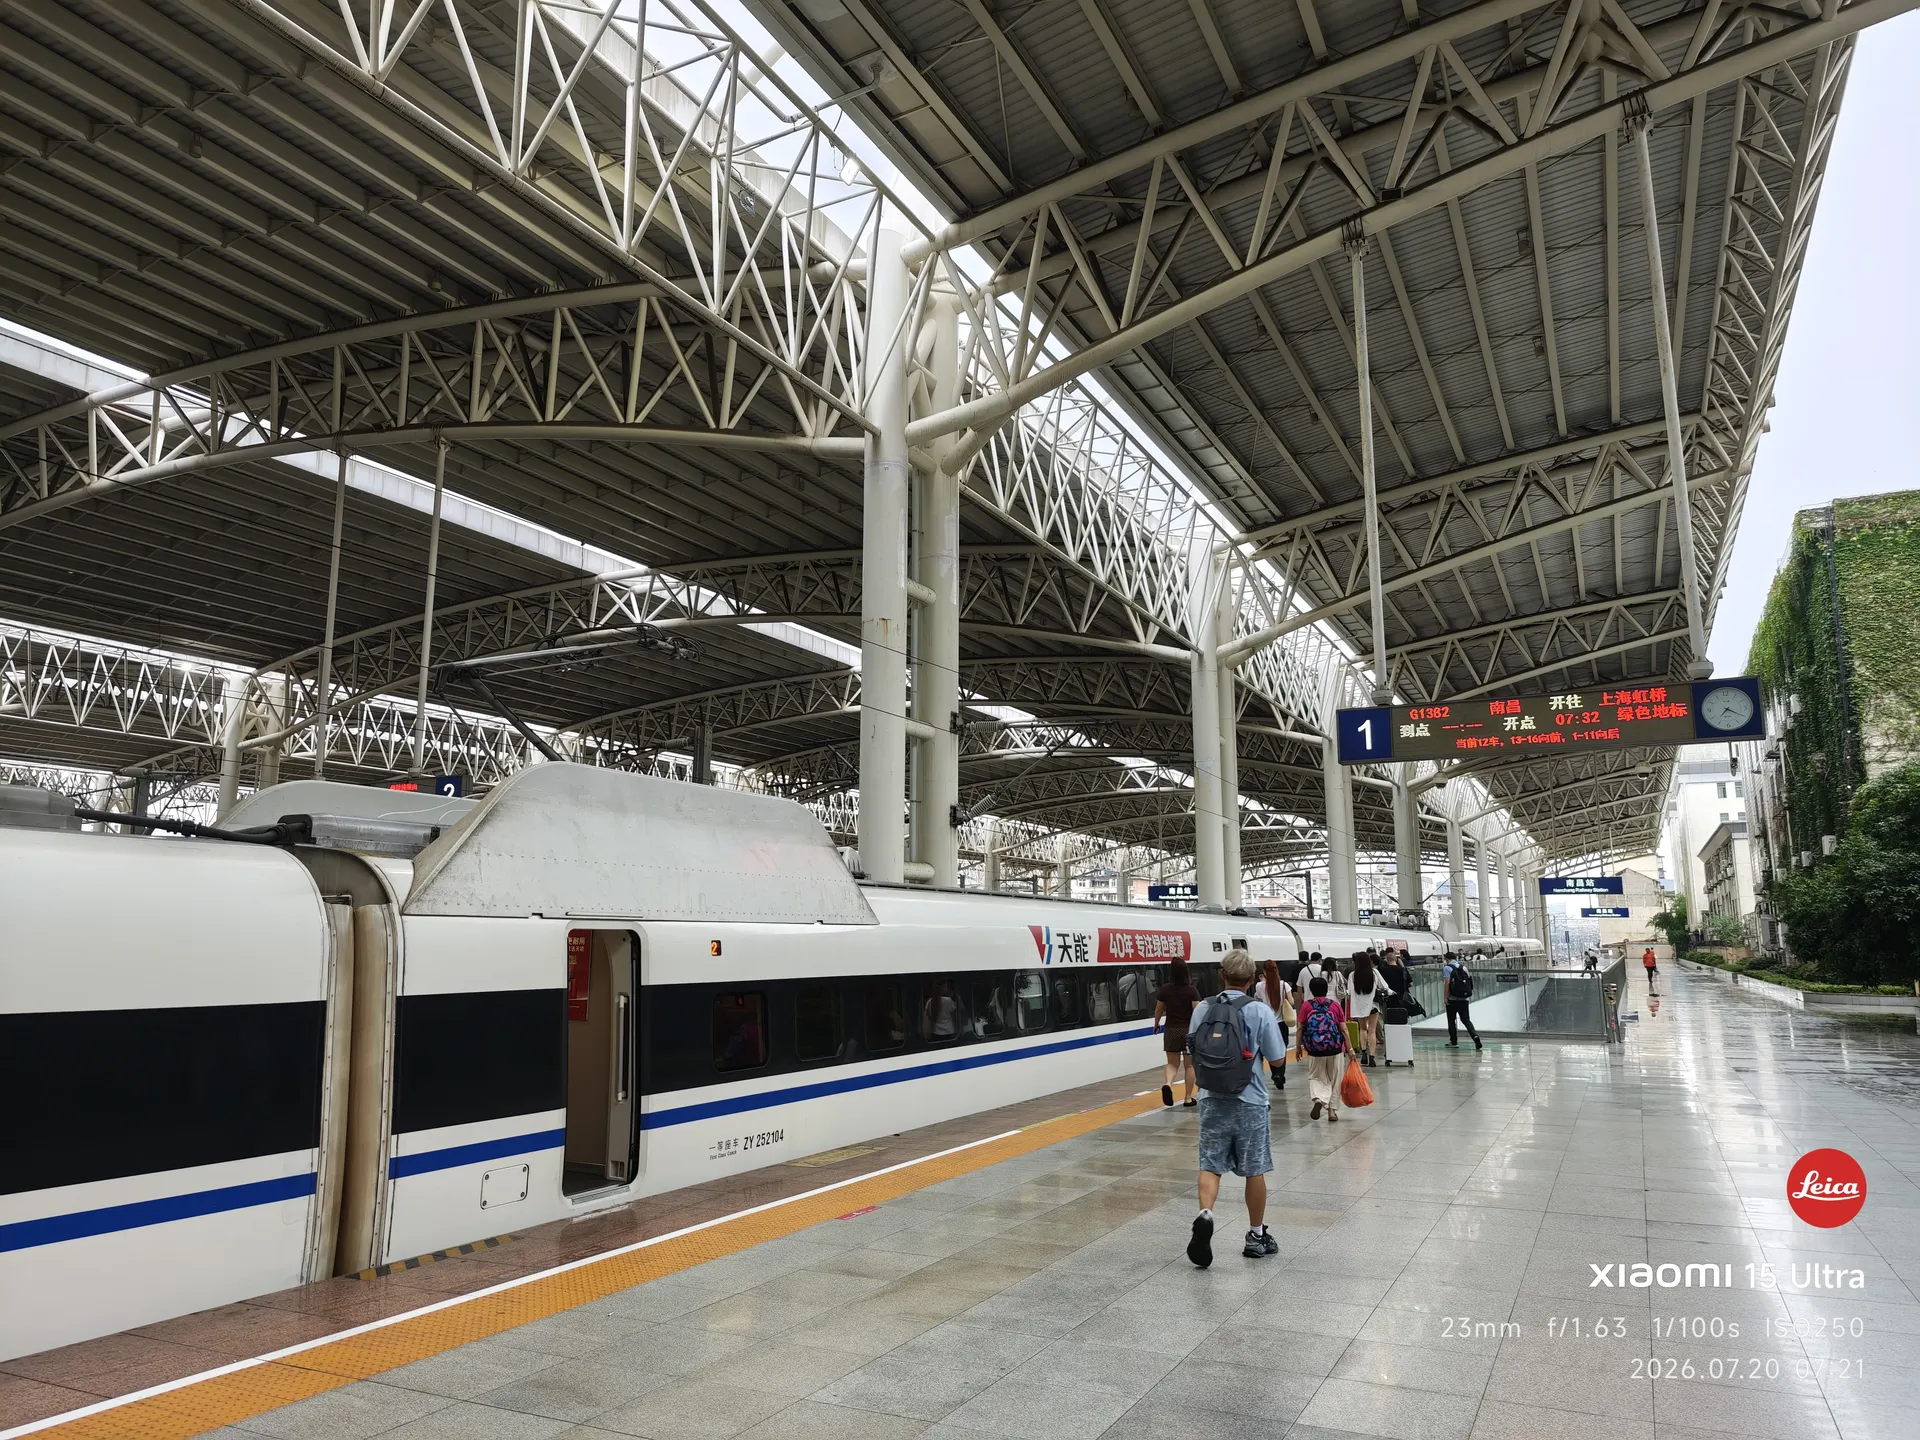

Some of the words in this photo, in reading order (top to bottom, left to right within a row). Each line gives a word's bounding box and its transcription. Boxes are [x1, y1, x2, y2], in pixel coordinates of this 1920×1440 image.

[1409, 706, 1451, 720] G1382
[1489, 699, 1522, 715] 南昌
[1549, 694, 1584, 710] 开往
[1599, 687, 1668, 707] 上海虹桥
[1400, 722, 1431, 738] 到点
[1503, 715, 1536, 731] 开点
[1555, 711, 1600, 726] 07:32
[1617, 702, 1688, 722] 绿色地标
[1357, 719, 1373, 750] 1
[443, 783, 455, 797] 2
[1566, 879, 1594, 887] 南昌站
[711, 941, 718, 955] 2
[1056, 932, 1089, 963] 天能
[1109, 932, 1135, 958] 40年
[1135, 934, 1185, 958] 专注绿色能源
[709, 1137, 739, 1151] 一等座车
[743, 1135, 754, 1150] ZY
[756, 1129, 784, 1147] 252104
